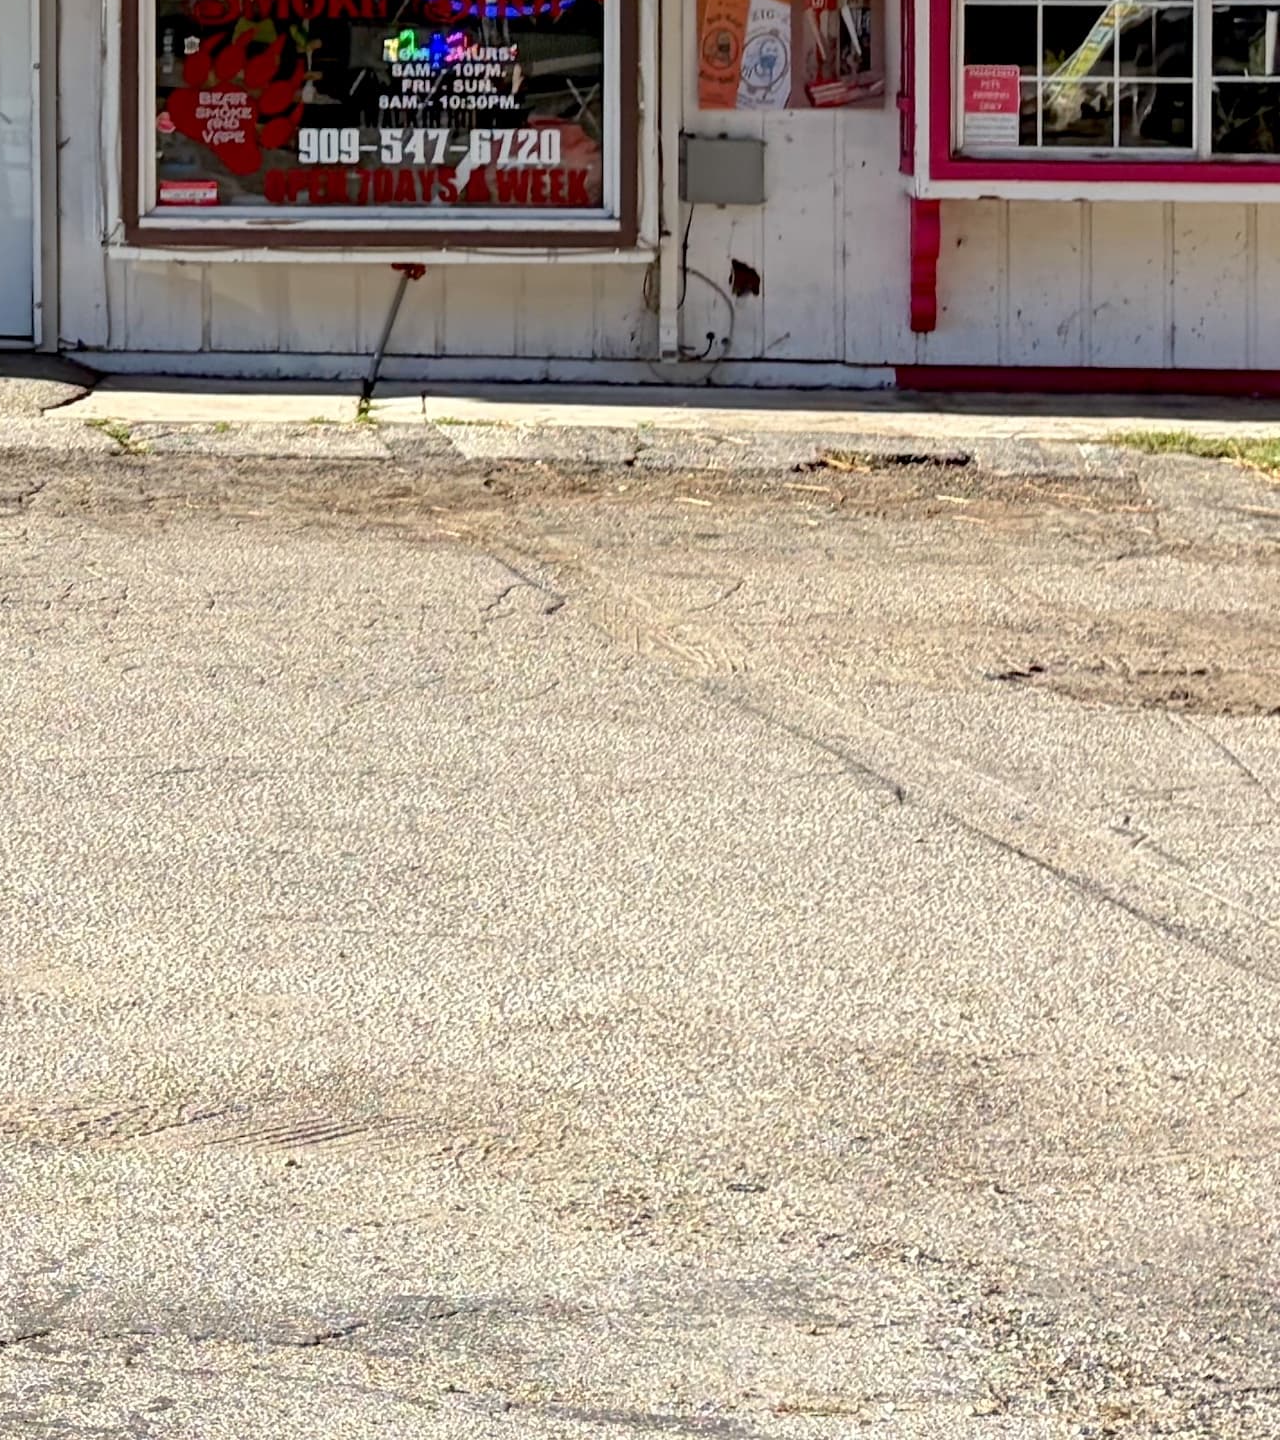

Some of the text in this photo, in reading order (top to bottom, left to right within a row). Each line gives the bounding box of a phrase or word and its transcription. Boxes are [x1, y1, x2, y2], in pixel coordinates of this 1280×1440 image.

[392, 63, 436, 77] 8AM.
[453, 63, 507, 77] 10PM.
[199, 92, 248, 106] BEAR
[195, 107, 253, 120] SMOKE
[206, 118, 240, 130] AND
[202, 130, 245, 145] VAPE
[298, 128, 561, 164] 909-547-6720
[263, 167, 348, 205] OPEN
[496, 167, 592, 205] WEEK
